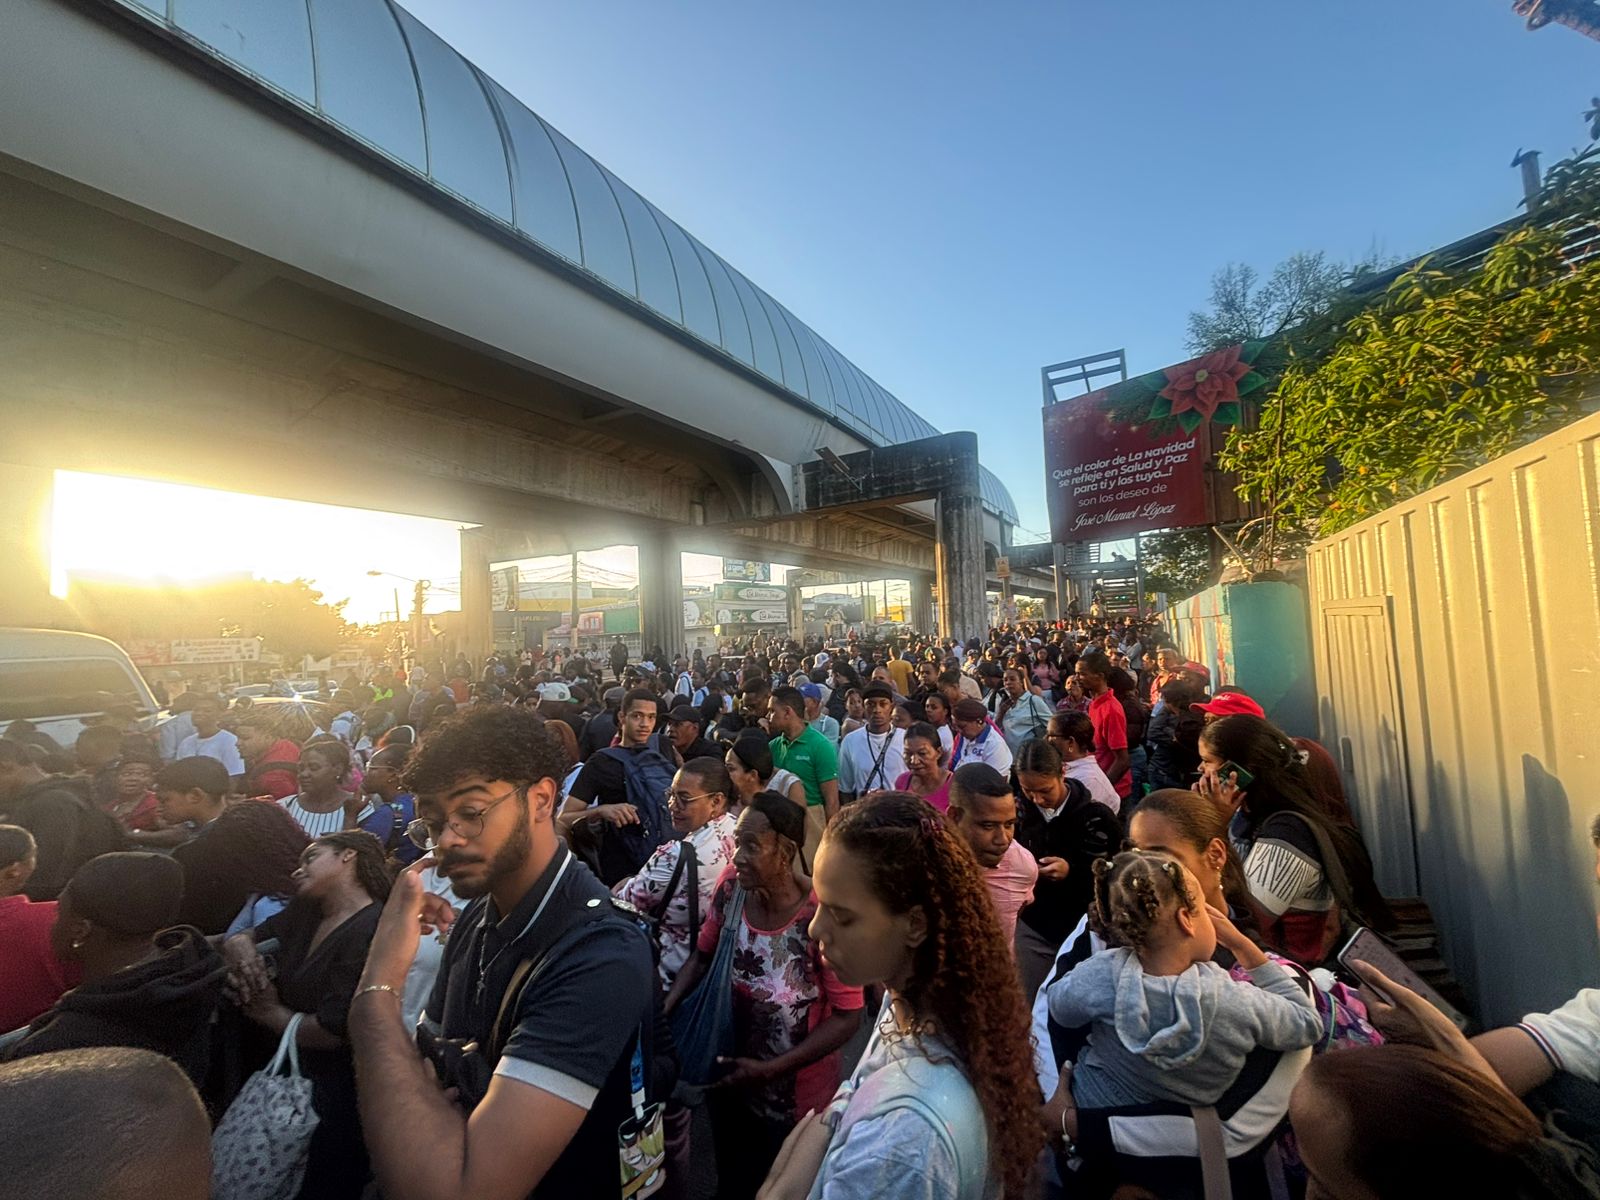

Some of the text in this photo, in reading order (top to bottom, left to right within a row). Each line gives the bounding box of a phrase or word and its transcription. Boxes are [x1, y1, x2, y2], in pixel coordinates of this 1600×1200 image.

[1052, 468, 1073, 480] Que
[1073, 464, 1083, 474] el
[1085, 460, 1110, 472] color
[1112, 456, 1127, 466] de
[1058, 453, 1188, 488] se refleje en Salud y Paz
[1073, 483, 1098, 496] para
[1100, 481, 1108, 490] ti
[1108, 480, 1117, 490] y
[1118, 476, 1134, 486] los
[1078, 483, 1168, 507] son los deseo de
[1096, 505, 1141, 525] Manuel
[1139, 501, 1177, 520] López
